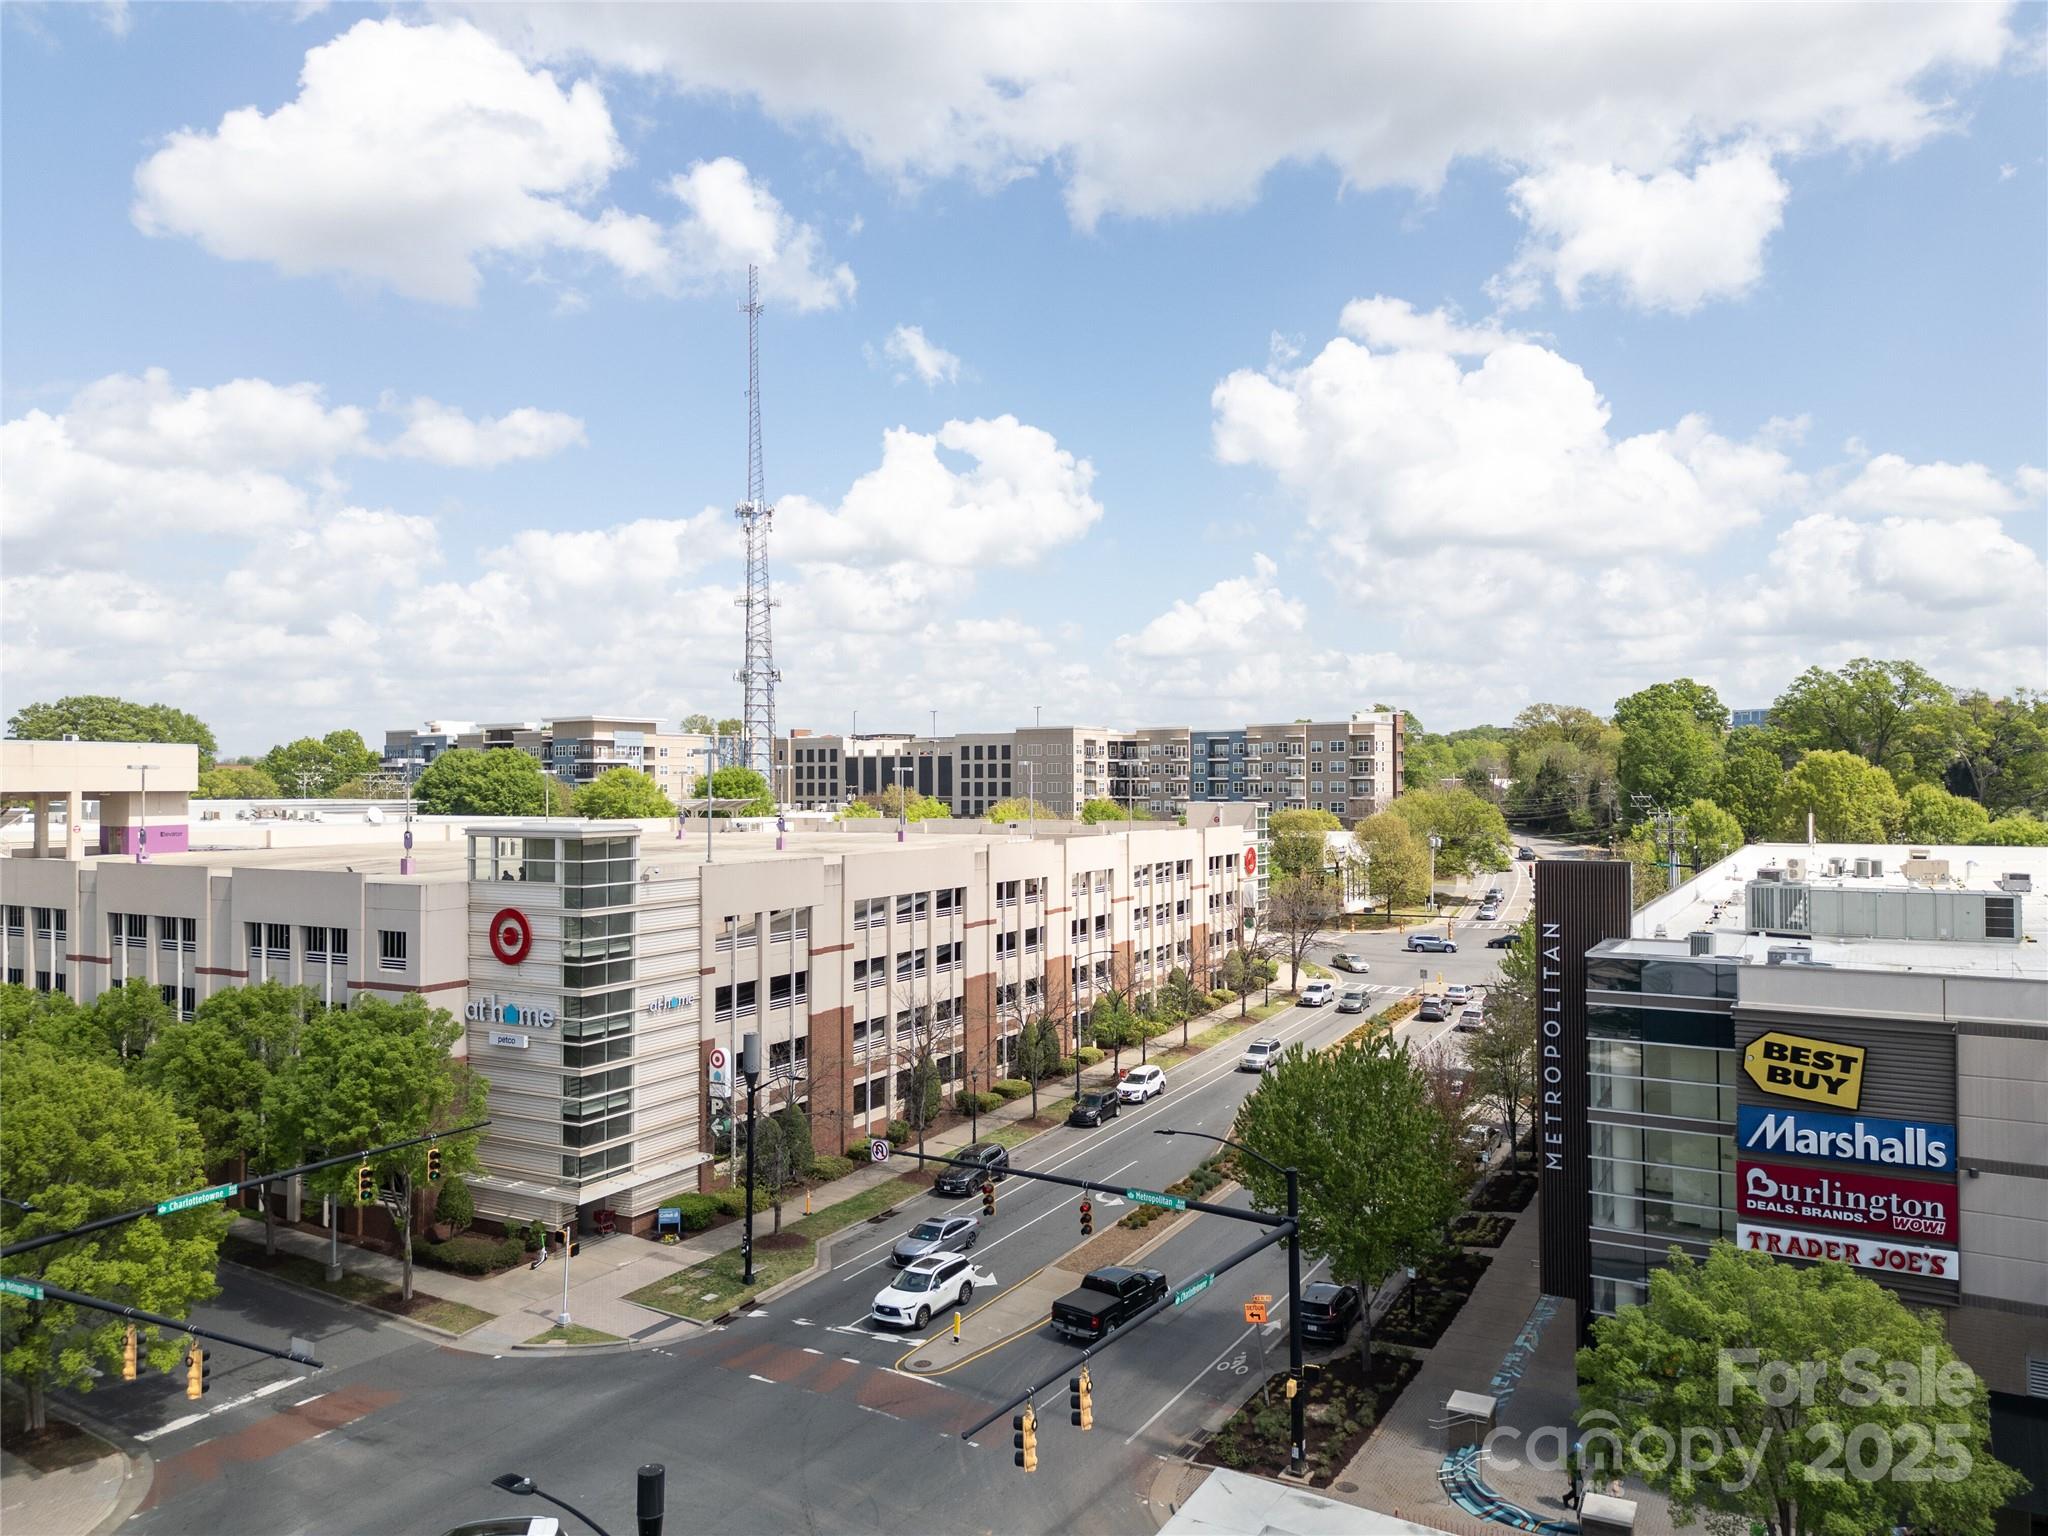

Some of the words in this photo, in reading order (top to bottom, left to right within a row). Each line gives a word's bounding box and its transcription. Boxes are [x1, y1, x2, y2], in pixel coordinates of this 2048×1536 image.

[464, 996, 486, 1022] at
[497, 1036, 516, 1045] petco
[1542, 923, 1563, 1171] METROPOLITAN
[1763, 1041, 1859, 1075] BEST
[1766, 1064, 1849, 1096] BUY
[1746, 1113, 1948, 1169] Marshalls
[168, 1189, 225, 1211] Charlottetowne
[1134, 1190, 1174, 1207] Metropolitan
[1746, 1167, 1947, 1222] Burlington
[1746, 1199, 1799, 1216] DEALS.
[1801, 1205, 1868, 1225] BRANDS.
[1892, 1216, 1947, 1236] WOW!
[1747, 1231, 1862, 1265] TRADER
[1870, 1246, 1948, 1276] JOE'S
